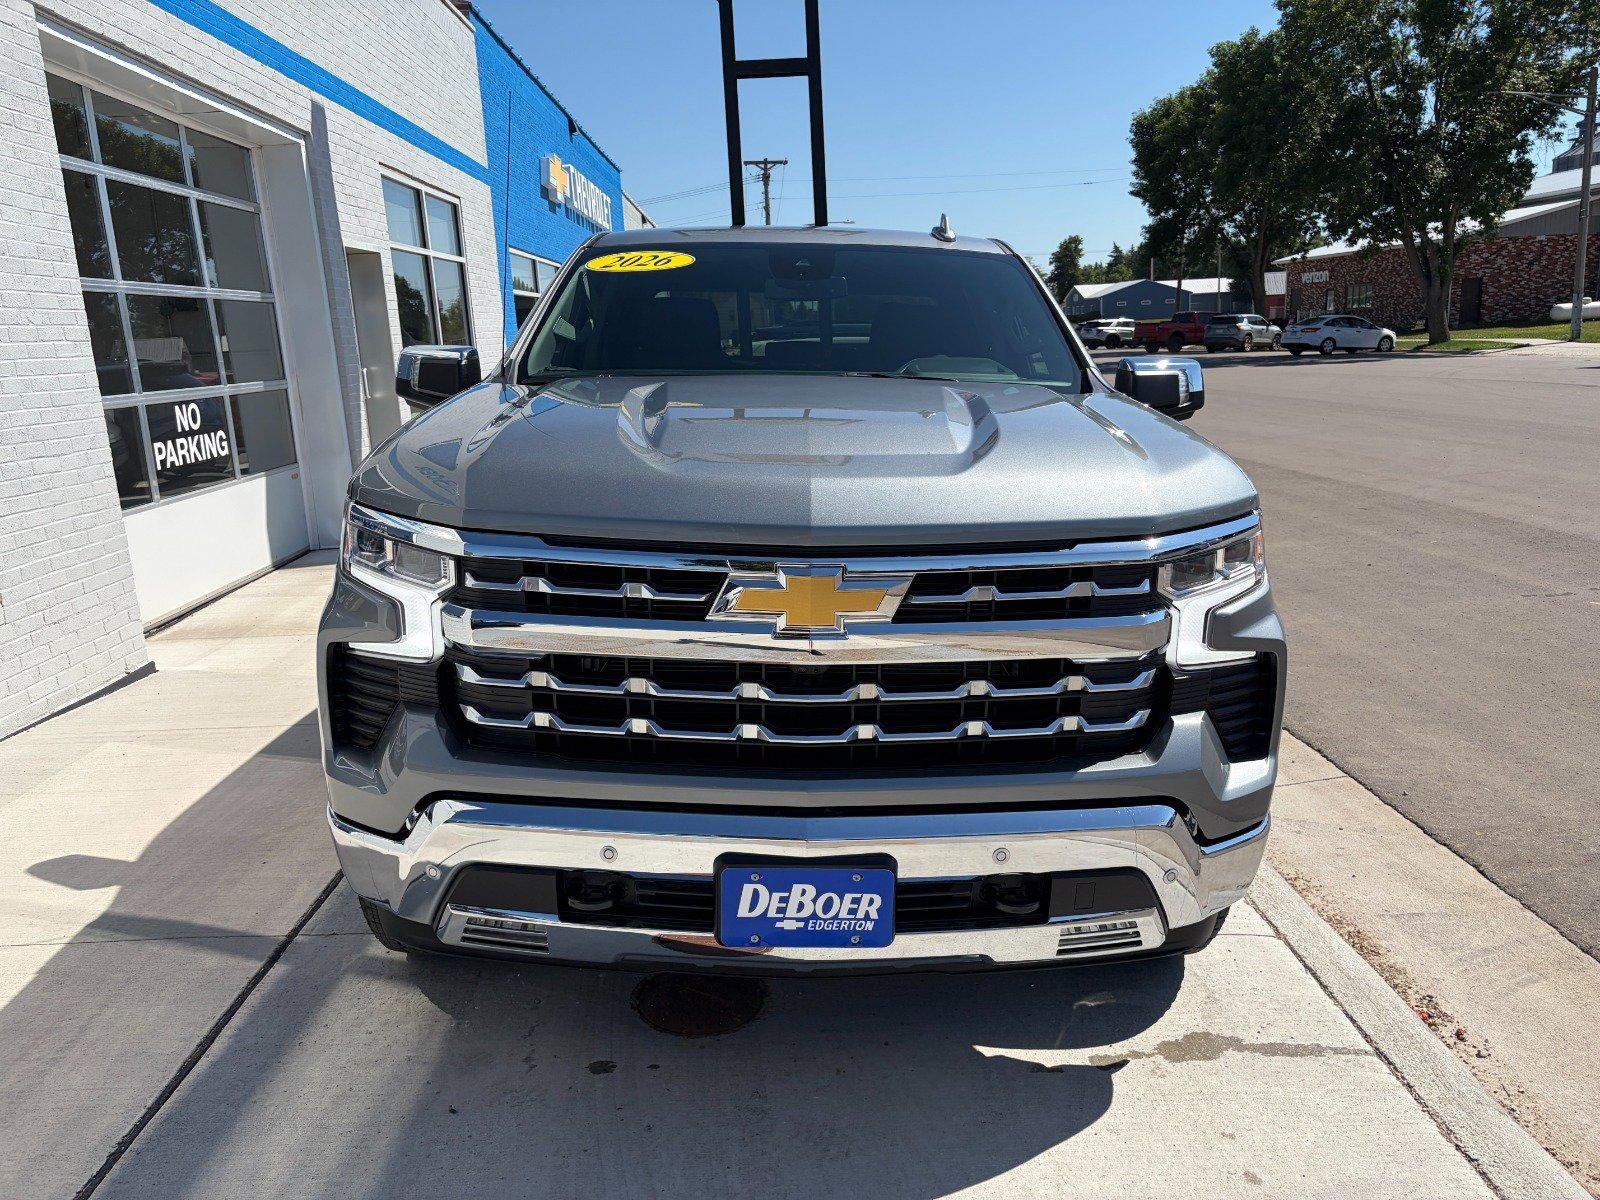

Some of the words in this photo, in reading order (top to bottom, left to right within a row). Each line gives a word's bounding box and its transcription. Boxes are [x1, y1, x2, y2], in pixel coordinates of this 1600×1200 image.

[600, 255, 679, 269] 2026
[1301, 270, 1329, 284] verizon
[174, 402, 201, 432] NO
[153, 430, 229, 471] PARKING
[807, 919, 875, 931] EDGERTON
